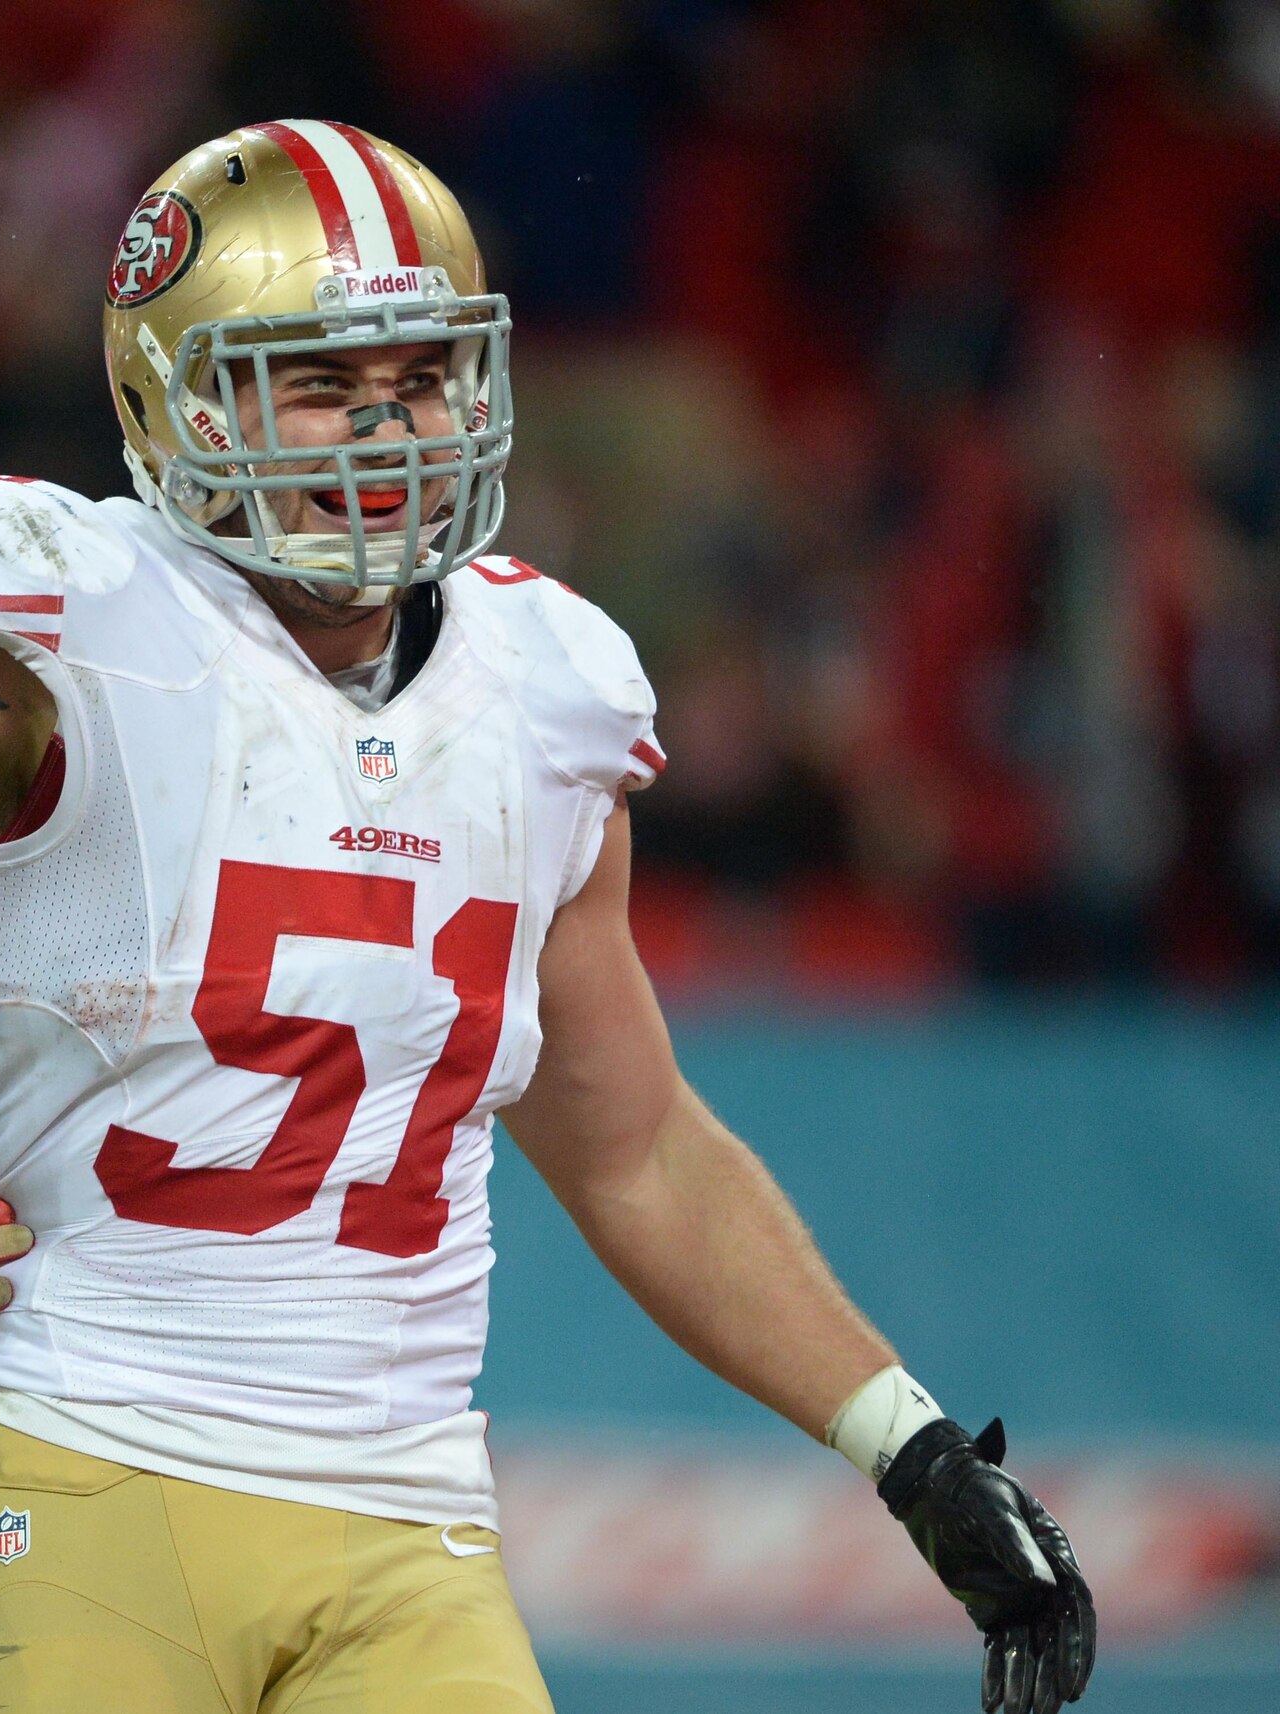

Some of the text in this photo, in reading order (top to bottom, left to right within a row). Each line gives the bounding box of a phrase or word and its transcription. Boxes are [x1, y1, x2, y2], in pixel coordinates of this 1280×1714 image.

[116, 205, 173, 294] SF
[345, 271, 419, 297] Riddell
[361, 756, 394, 778] NFL
[329, 826, 441, 863] 49ERS
[94, 858, 518, 1258] 51
